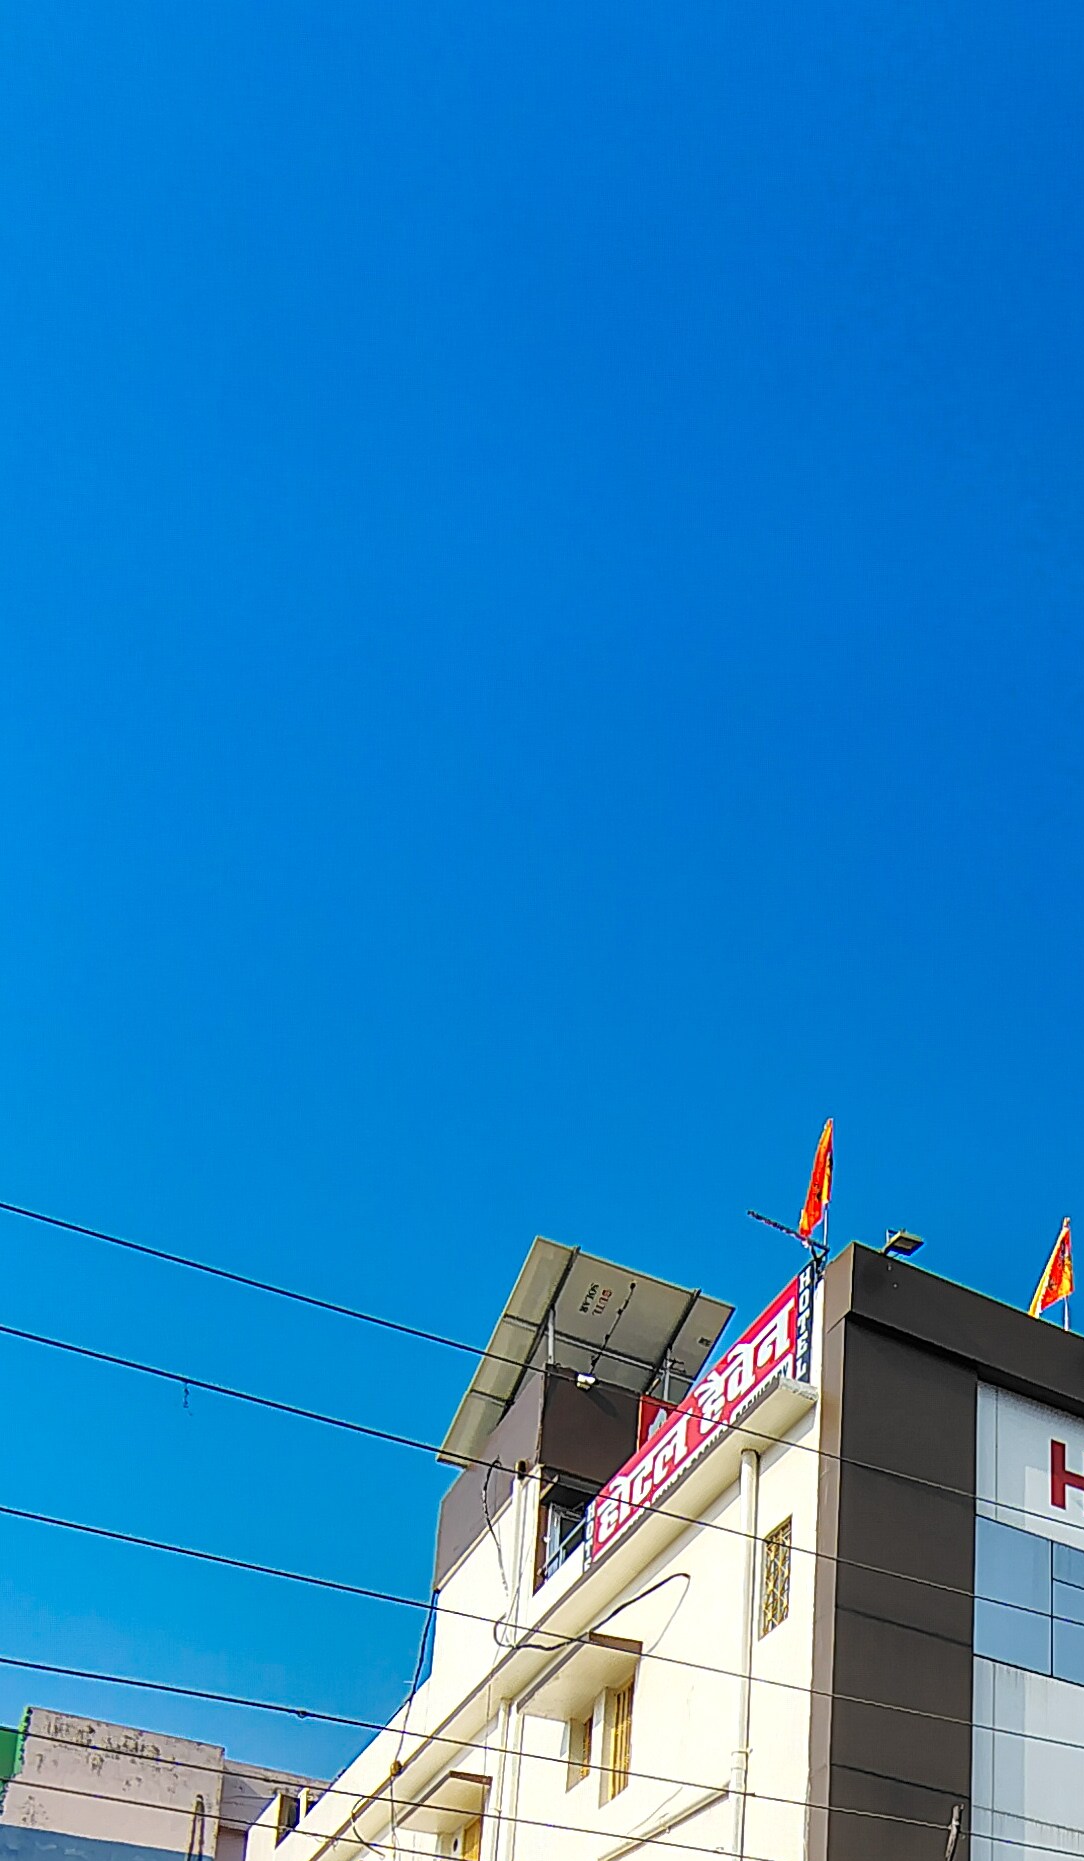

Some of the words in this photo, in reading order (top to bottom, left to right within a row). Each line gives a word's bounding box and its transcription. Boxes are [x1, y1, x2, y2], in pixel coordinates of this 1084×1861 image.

[579, 1282, 600, 1313] SOLAR
[796, 1265, 811, 1381] HOTEL
[597, 1408, 694, 1543] होटल
